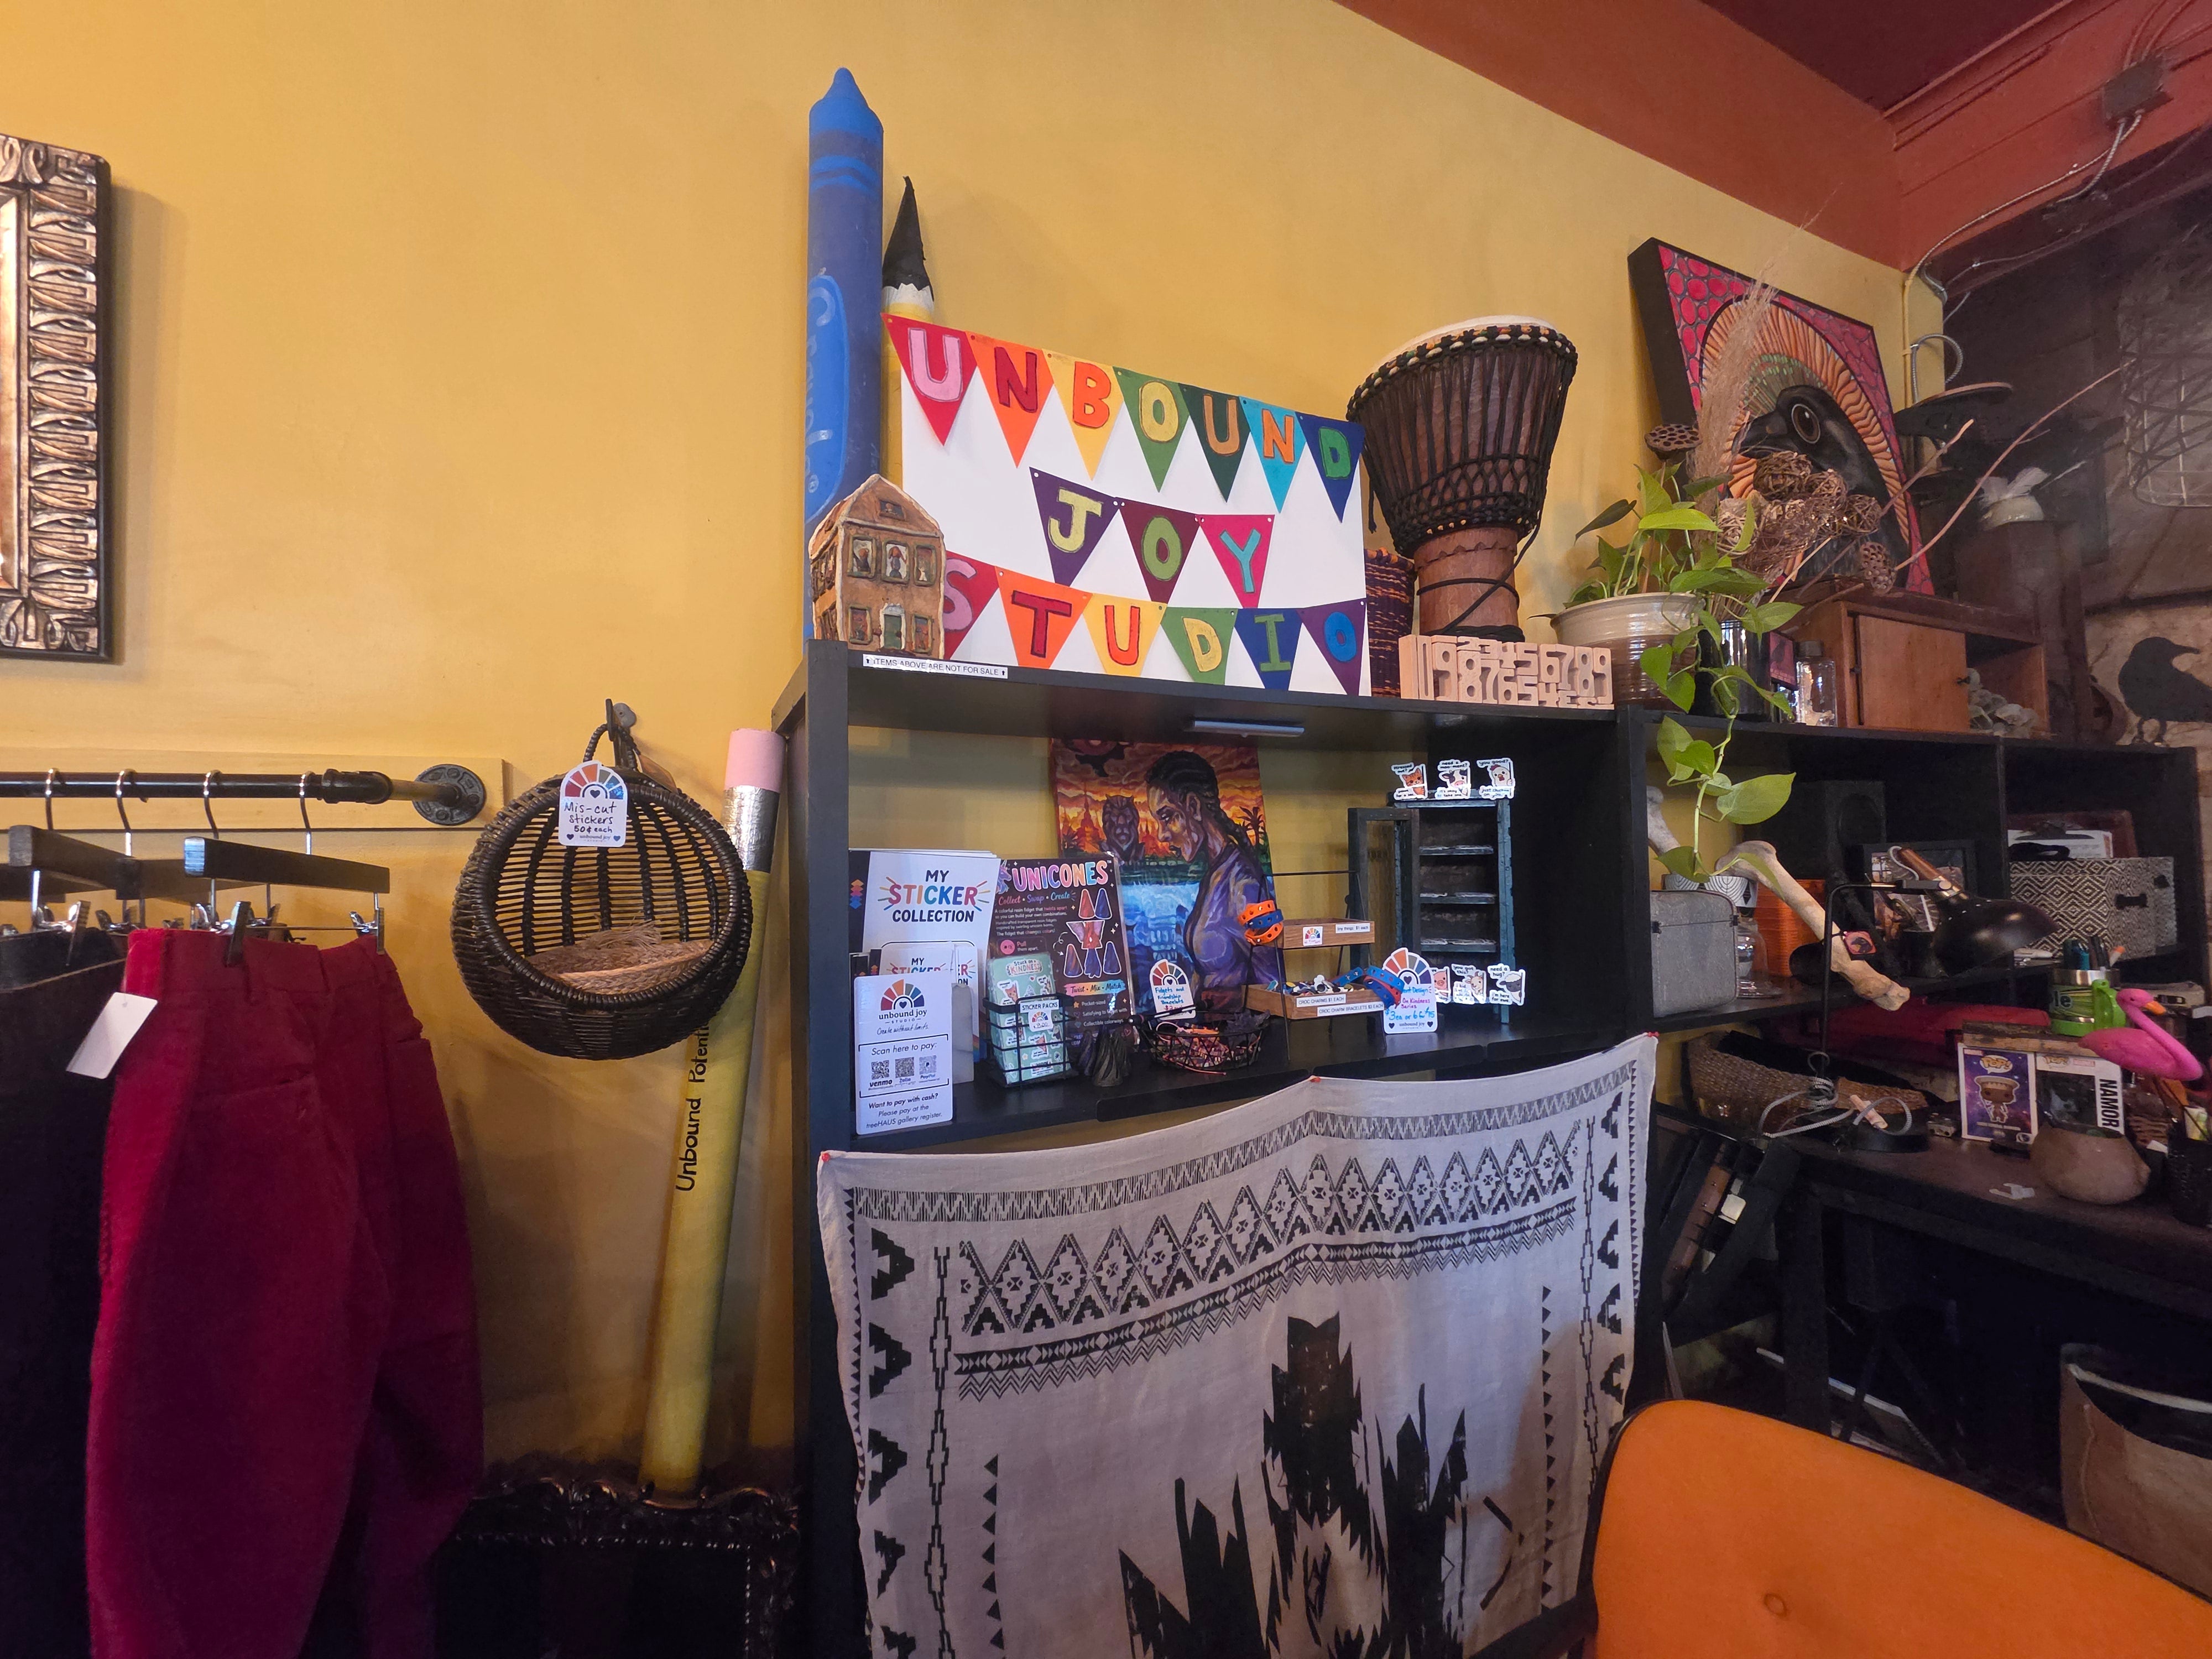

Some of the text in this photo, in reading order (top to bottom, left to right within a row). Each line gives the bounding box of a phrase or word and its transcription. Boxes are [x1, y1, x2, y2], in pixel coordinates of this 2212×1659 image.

[907, 327, 1350, 478] UNBOUND
[1048, 490, 1261, 593] JOY
[942, 557, 1357, 671] STUDIO
[900, 660, 926, 669] ABOVE
[945, 664, 961, 672] NOT
[963, 665, 978, 674] FOR
[980, 667, 999, 676] SALE
[564, 801, 617, 814] Mis-cut
[573, 825, 592, 834] 50¢
[925, 870, 950, 883] MY
[1011, 860, 1109, 892] UNICONES
[888, 884, 978, 906] STICKER
[998, 891, 1071, 906] Collect Swap Create
[892, 910, 975, 922] COLLECTION
[911, 957, 925, 966] MY
[1010, 963, 1040, 974] KINDNESS
[1070, 985, 1085, 994] Twist
[1105, 983, 1121, 991] Match
[878, 1009, 927, 1020] unbound joy
[877, 1027, 893, 1036] Create
[893, 1024, 914, 1033] without
[920, 1042, 938, 1051] pay:
[1980, 1056, 2011, 1070] POP!
[894, 1099, 906, 1107] pay
[921, 1093, 938, 1101] cash?
[2099, 1078, 2120, 1129] NAMOR
[676, 1025, 709, 1191] Unbound Potenti
[899, 1108, 911, 1117] pay
[865, 1118, 896, 1129] treeHAUS
[898, 1115, 919, 1125] gallery
